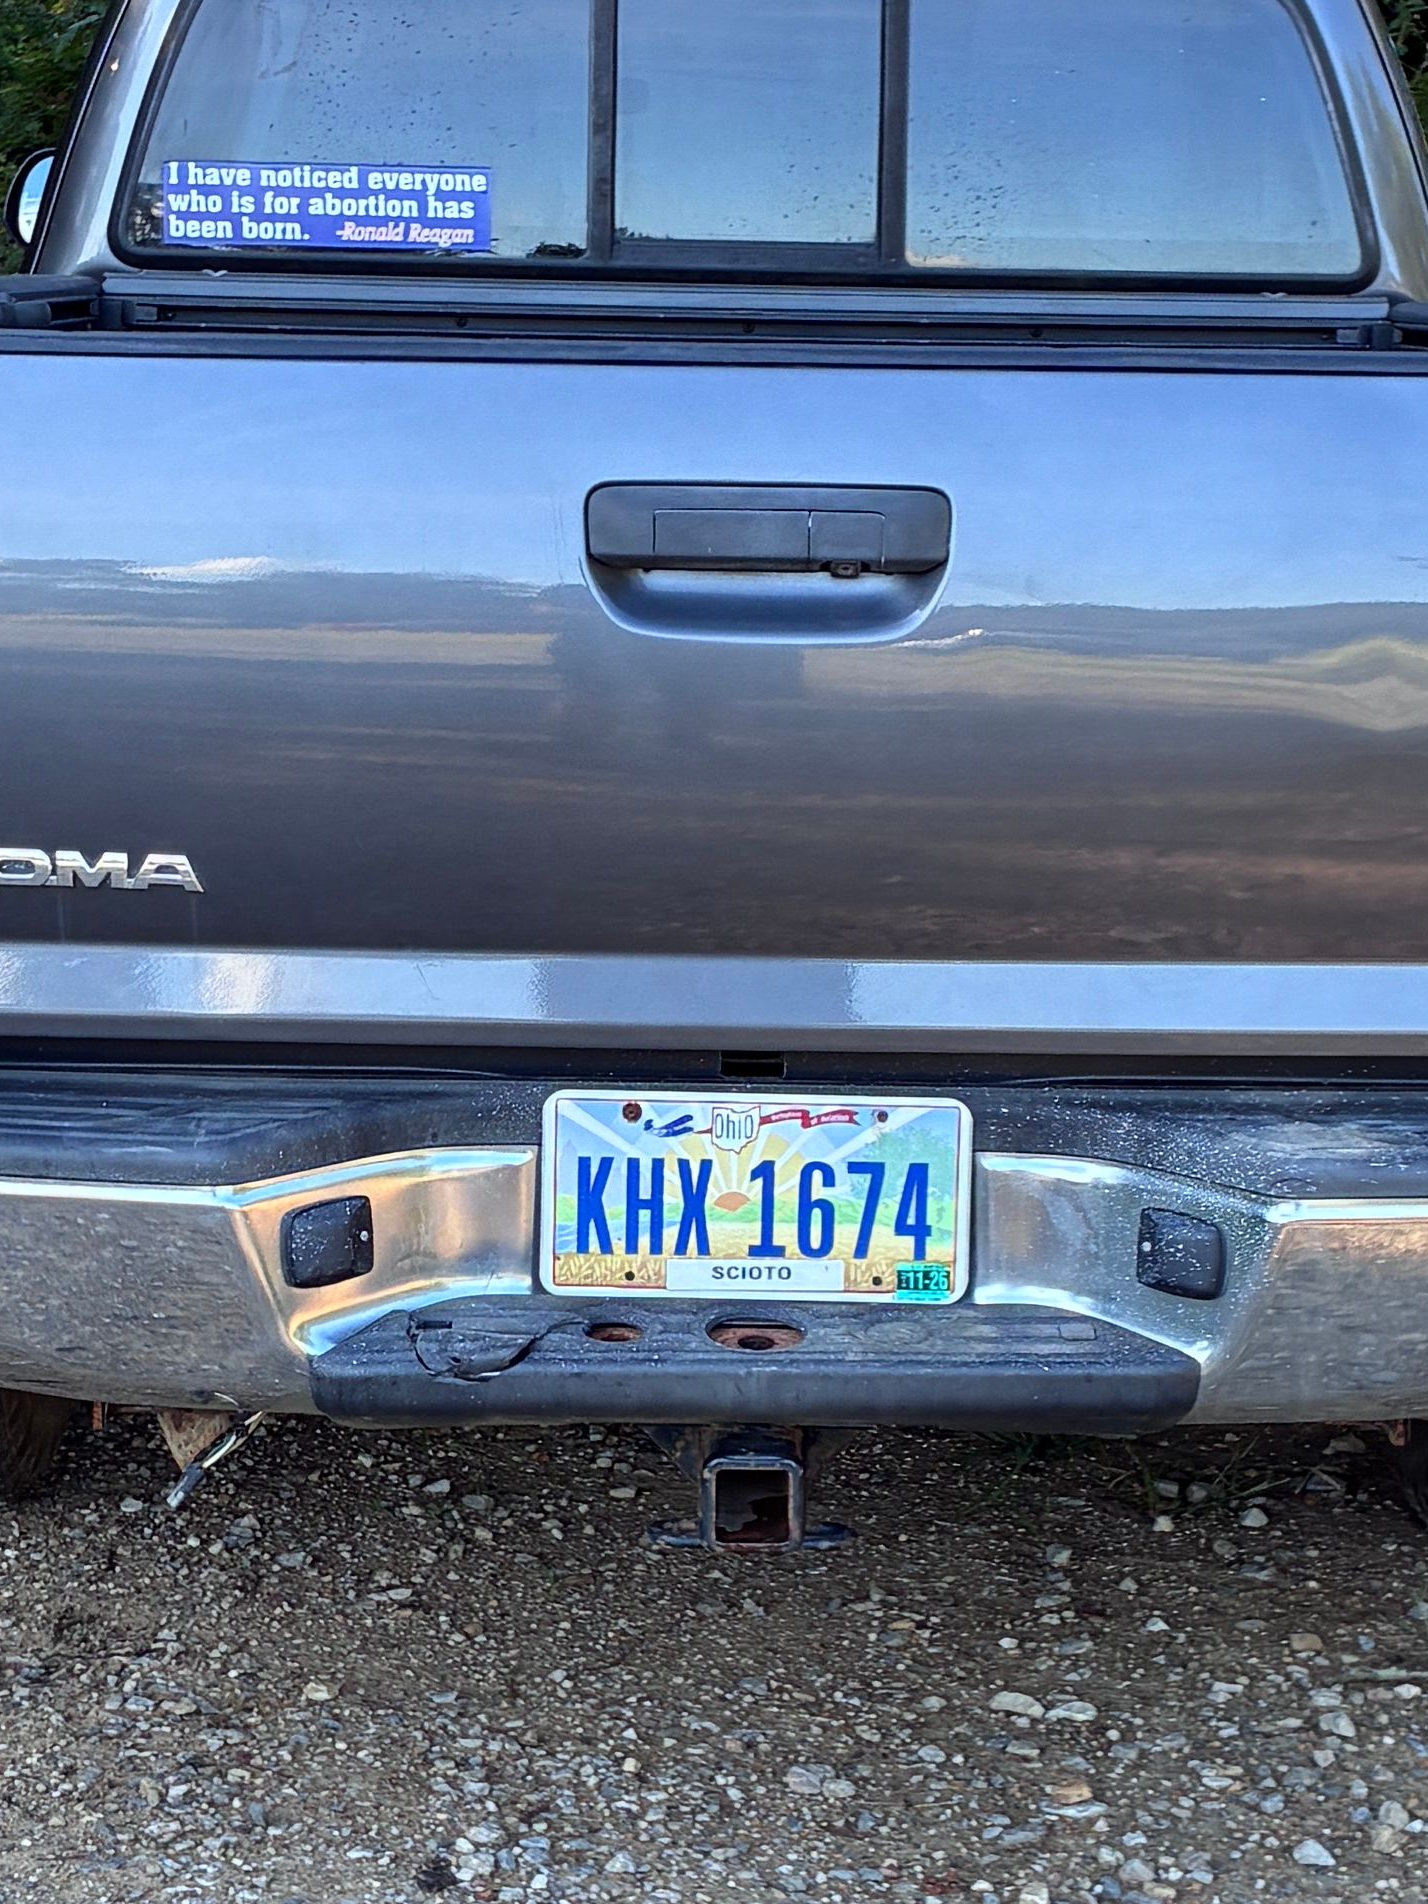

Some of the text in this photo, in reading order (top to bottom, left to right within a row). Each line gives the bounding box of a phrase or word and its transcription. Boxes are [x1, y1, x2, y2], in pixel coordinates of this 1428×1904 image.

[168, 161, 487, 195] I have noticed everyone
[167, 189, 475, 219] who is for abortion has
[168, 214, 233, 238] been
[241, 216, 311, 240] born.
[407, 222, 474, 248] Reagan
[714, 1113, 754, 1139] Ohio
[576, 1155, 933, 1262] KHX 1674
[711, 1265, 792, 1281] SCIOTO
[907, 1270, 948, 1290] 11-26
